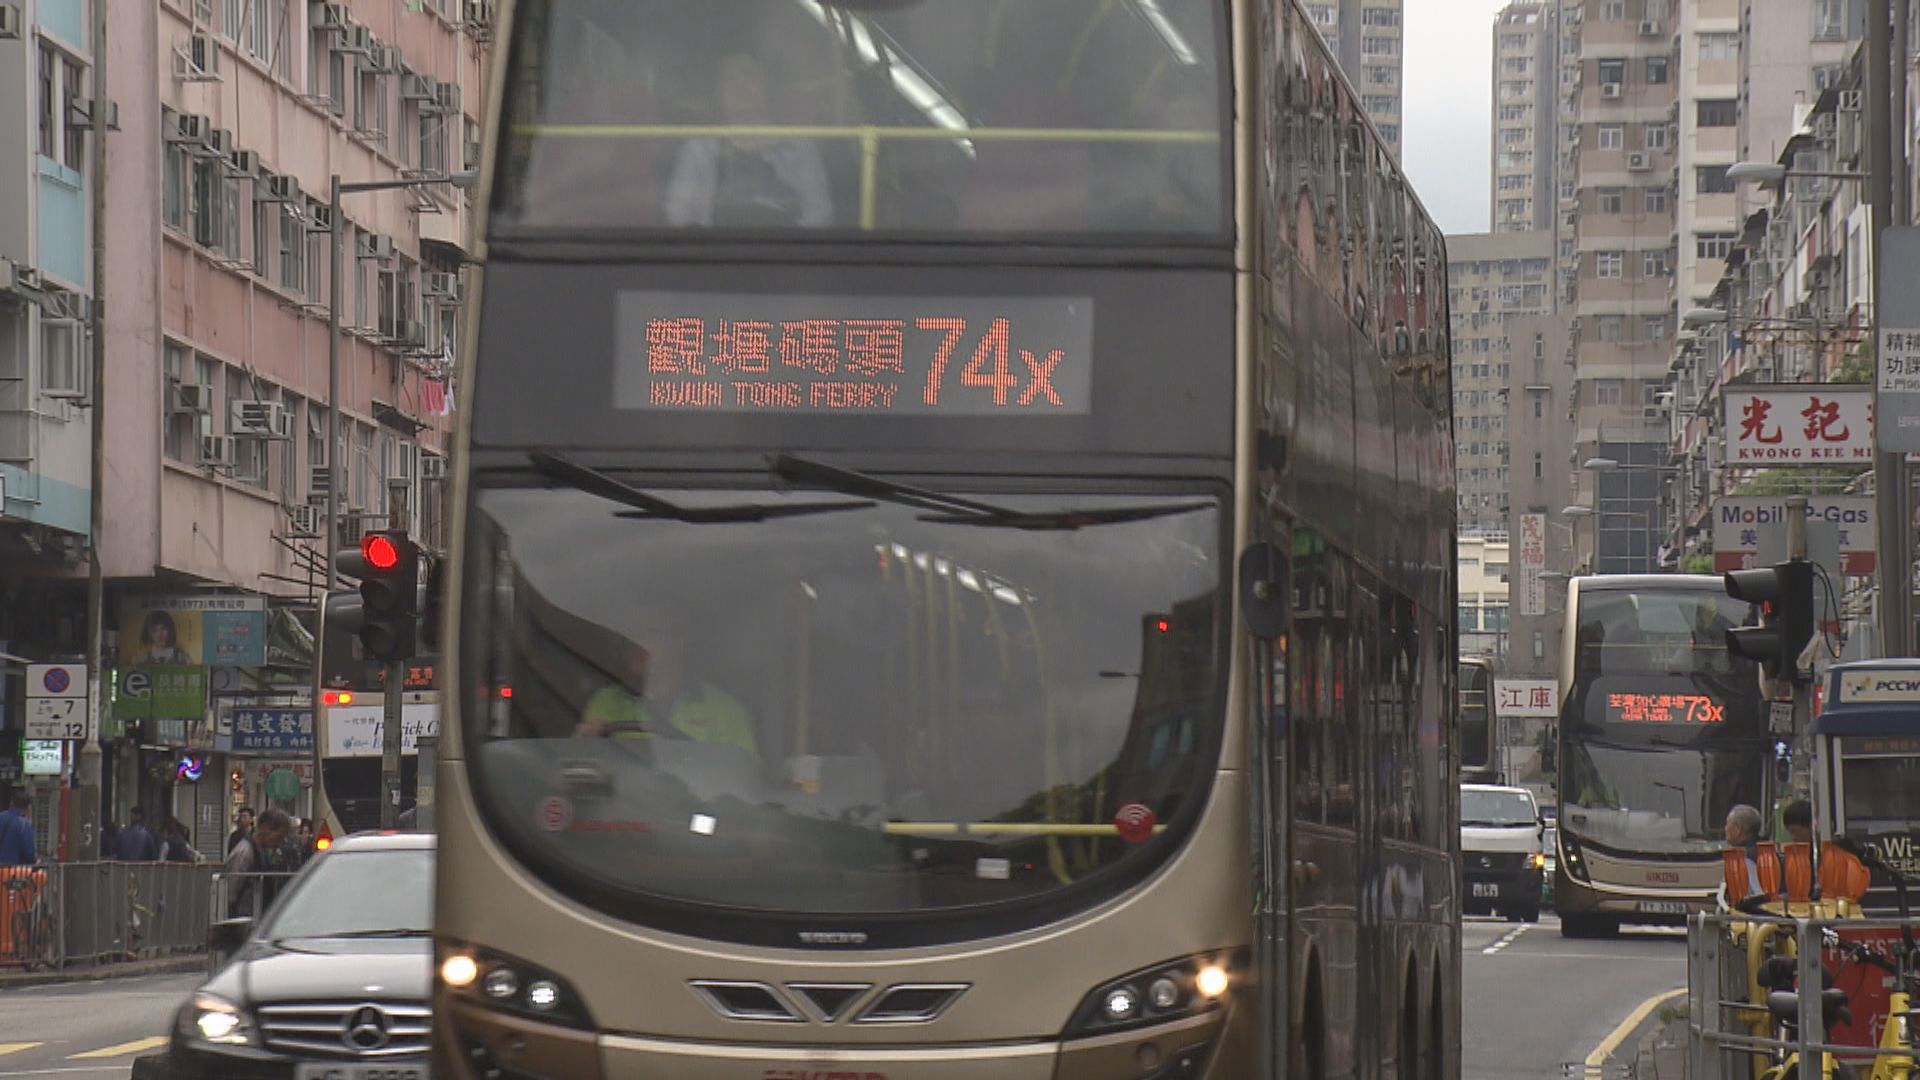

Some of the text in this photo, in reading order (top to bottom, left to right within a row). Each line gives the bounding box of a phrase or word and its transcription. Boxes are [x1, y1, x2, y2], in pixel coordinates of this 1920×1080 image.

[646, 318, 904, 375] 觀塘碼頭
[1739, 396, 1872, 443] 光記
[1739, 448, 1801, 459] KWONG
[1811, 448, 1844, 459] KEE
[1722, 506, 1868, 523] Mobil P-Gas
[64, 700, 74, 714] 7
